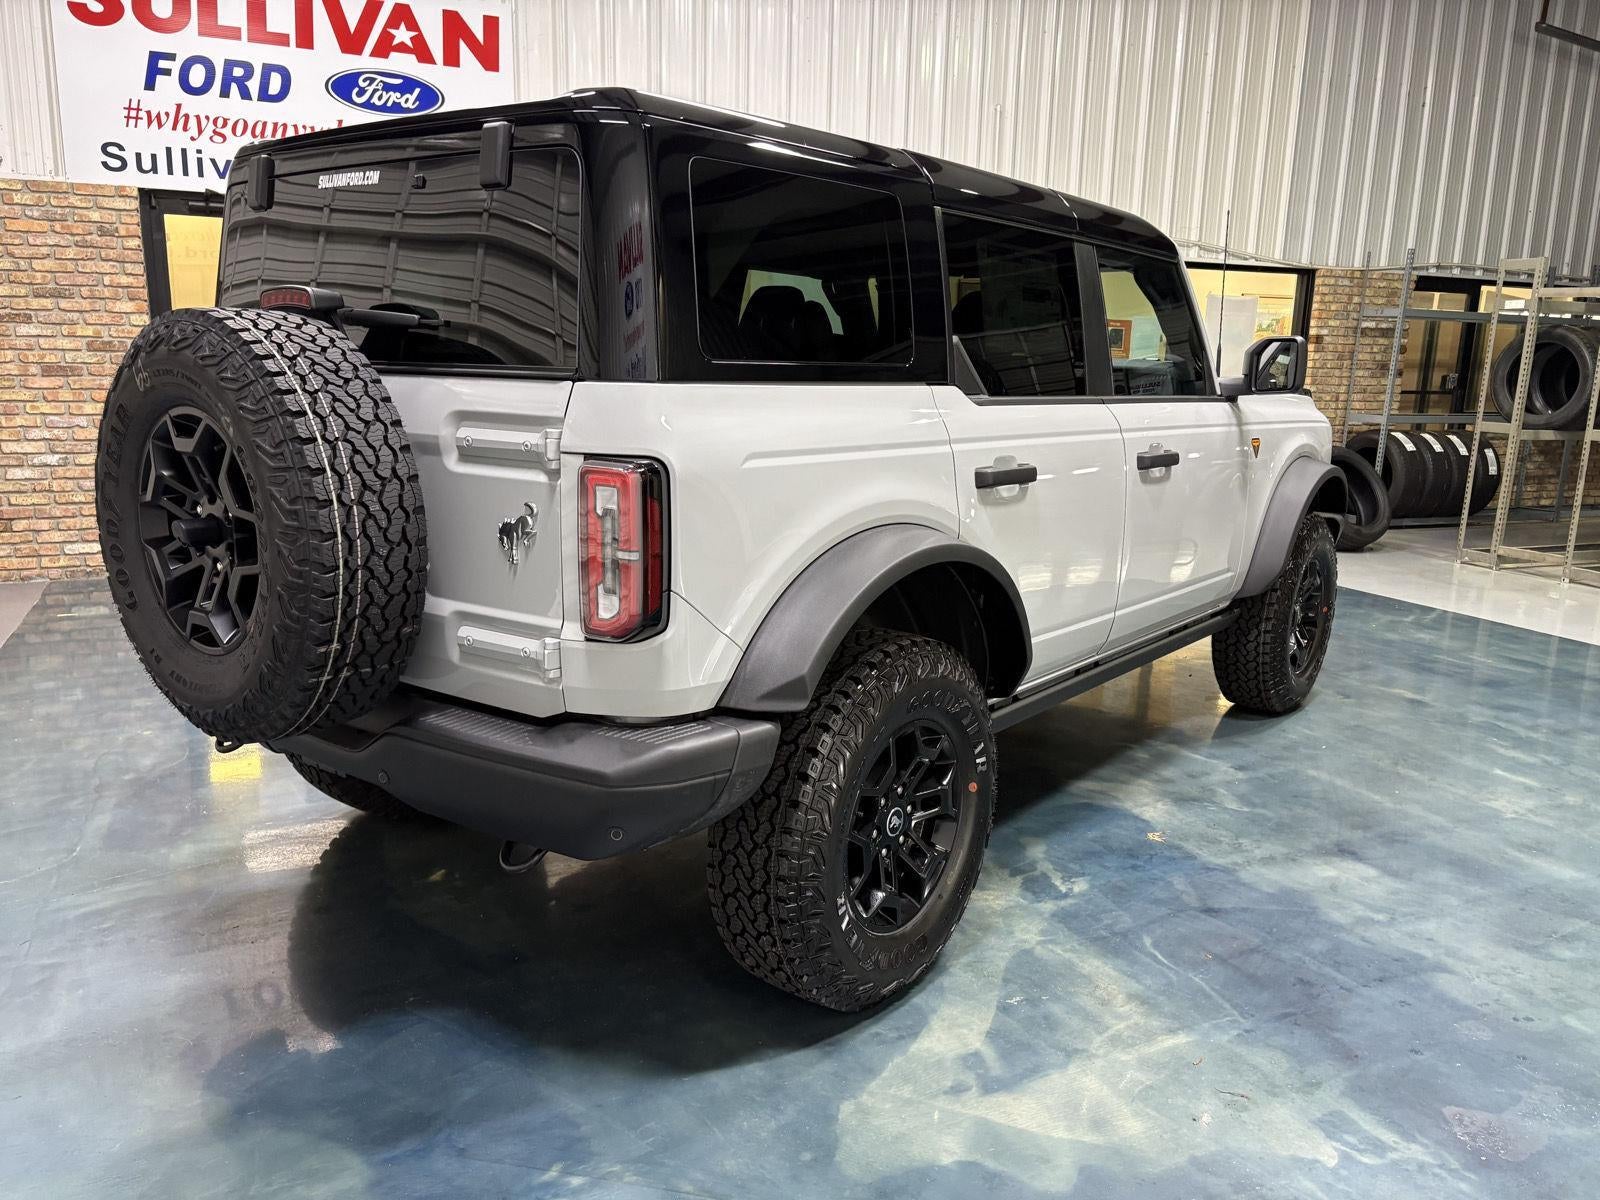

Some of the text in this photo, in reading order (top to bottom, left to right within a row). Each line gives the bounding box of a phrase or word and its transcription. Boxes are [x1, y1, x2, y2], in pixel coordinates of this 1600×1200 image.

[144, 50, 292, 103] FORD
[352, 73, 419, 109] Ford
[123, 98, 343, 145] #whygoan
[318, 170, 380, 189] SULLIVANFORD.COM
